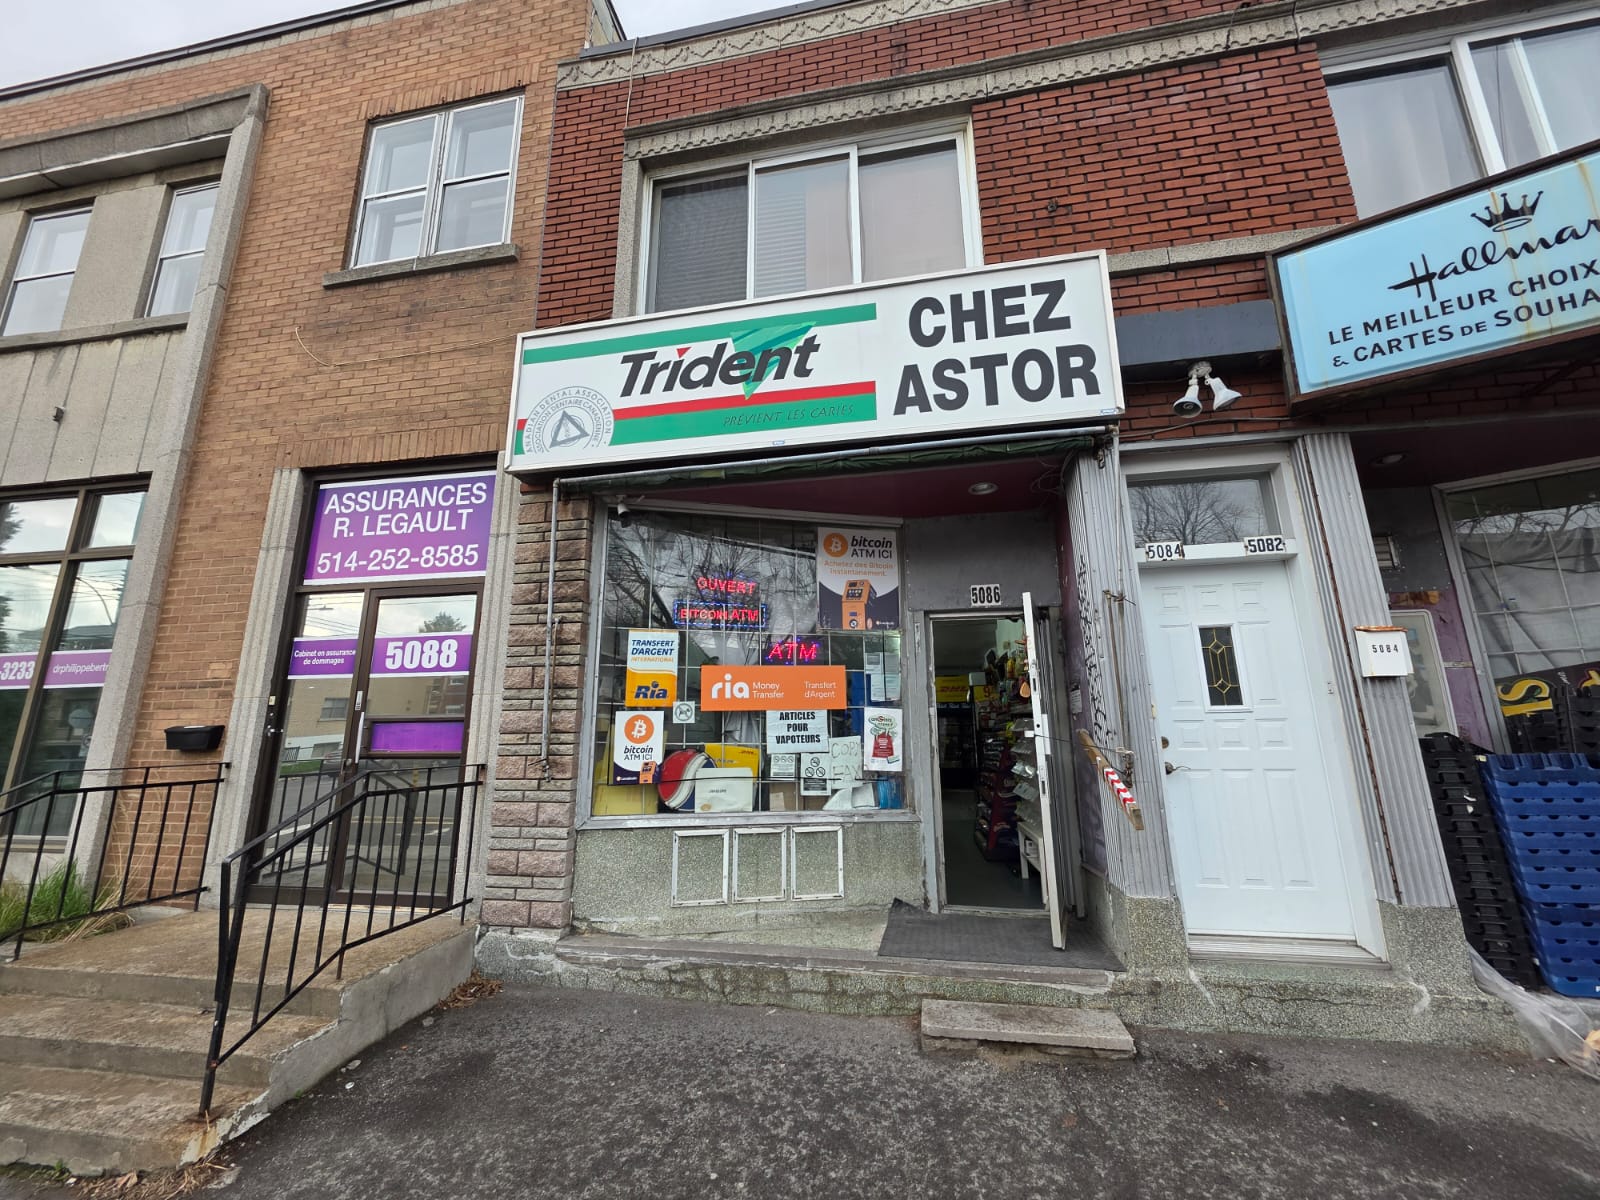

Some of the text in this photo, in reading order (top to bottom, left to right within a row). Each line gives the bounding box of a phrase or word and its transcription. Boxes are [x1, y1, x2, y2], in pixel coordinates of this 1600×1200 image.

[1329, 259, 1600, 346] LE MEILLEUR CHOIX
[909, 279, 1071, 348] CHEZ
[1333, 288, 1600, 368] & CARTES DE SOUHA
[620, 334, 820, 398] Trident
[893, 344, 1101, 416] ASTOR
[540, 389, 572, 410] DENTAL
[575, 389, 613, 434] ASSOCIATION
[787, 409, 805, 421] LES
[810, 404, 854, 419] CARIES
[324, 482, 487, 515] ASSURANCES
[333, 509, 473, 538] R. LEGAULT
[851, 536, 892, 548] bitcoin
[1148, 537, 1284, 558] 5084 5082
[317, 544, 479, 574] 514-252-8585
[851, 548, 892, 559] ATM ICI
[697, 577, 756, 595] OUVERT
[971, 586, 1000, 604] 5086
[680, 609, 758, 621] BITCOIN ATM
[385, 639, 458, 670] 5088
[631, 648, 674, 656] D'ARGENT
[769, 641, 817, 660] ATM
[1372, 644, 1399, 653] 5084
[303, 657, 344, 665] de dommages
[0, 661, 36, 680] 3233
[635, 681, 668, 699] Ria
[711, 673, 836, 699] ria Money Transfert
[780, 712, 815, 720] ARTICLES
[787, 723, 808, 732] POUR
[776, 735, 820, 744] VAPOTEURS
[624, 745, 653, 754] bitcoin
